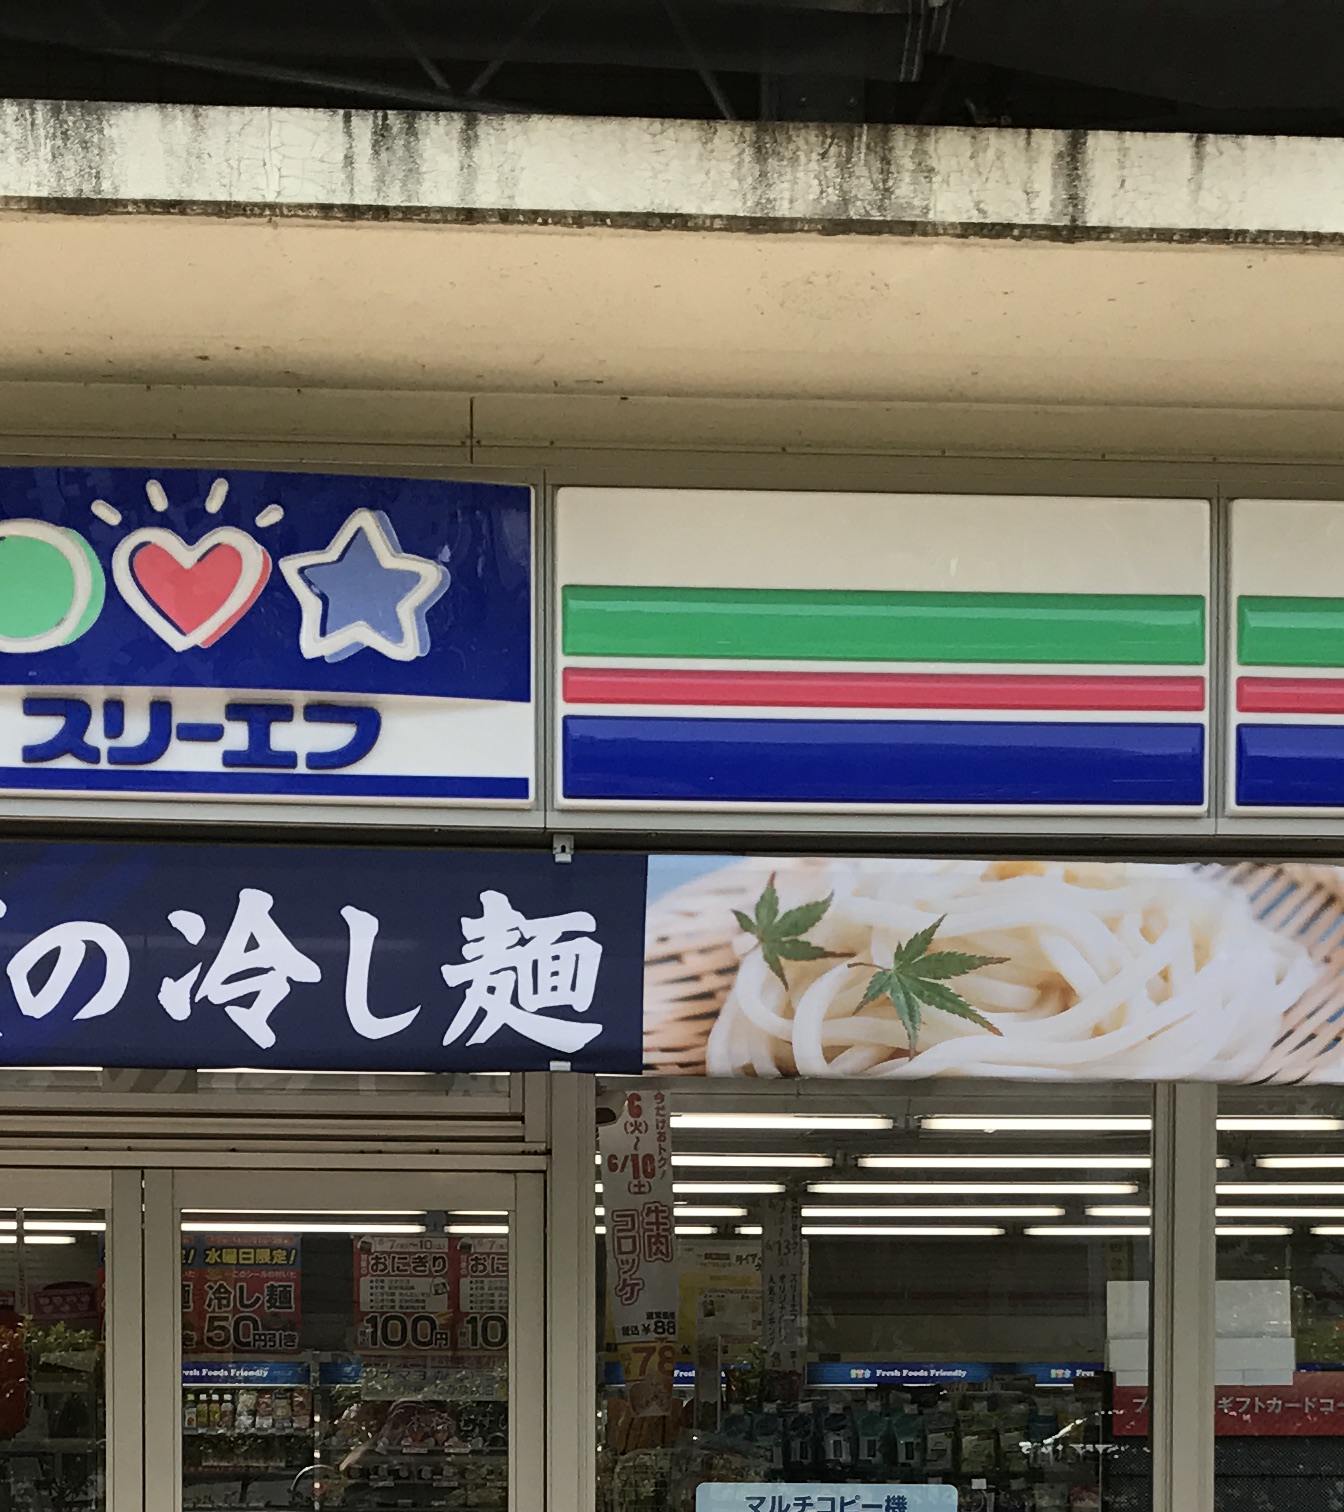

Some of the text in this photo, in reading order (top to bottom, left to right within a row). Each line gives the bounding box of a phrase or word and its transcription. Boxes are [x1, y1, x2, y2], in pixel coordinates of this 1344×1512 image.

[21, 697, 382, 770] スリーエフ
[642, 1201, 673, 1262] 牛肉
[369, 1254, 448, 1275] おにぎり
[612, 1209, 645, 1306] コロッケ
[205, 1282, 296, 1312] 冷し麺
[365, 1313, 451, 1349] 100円
[902, 1369, 928, 1378] Foods
[930, 1369, 967, 1379] Friendly
